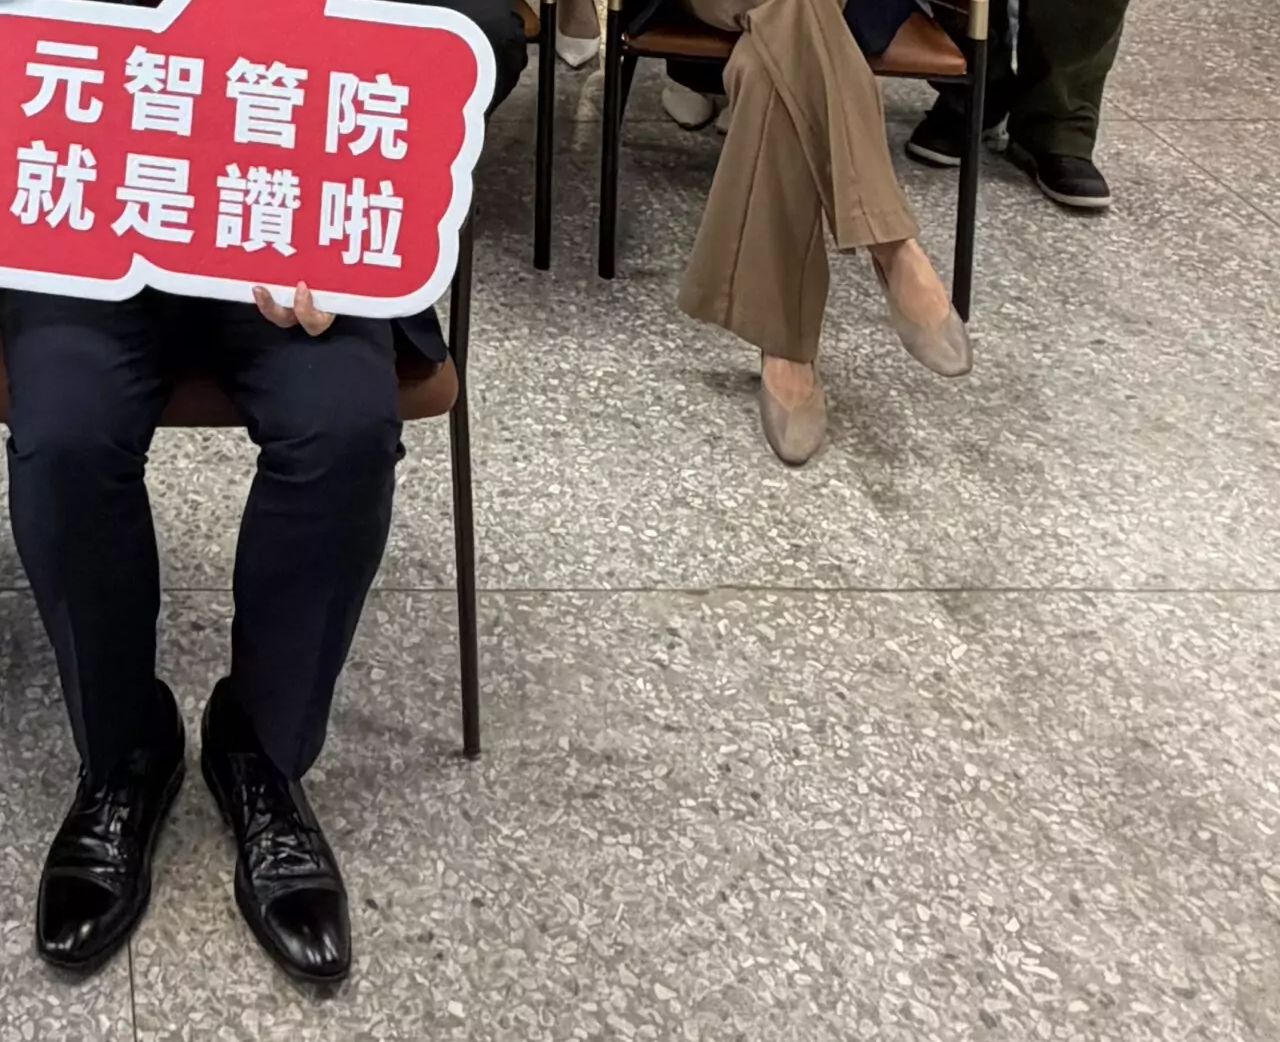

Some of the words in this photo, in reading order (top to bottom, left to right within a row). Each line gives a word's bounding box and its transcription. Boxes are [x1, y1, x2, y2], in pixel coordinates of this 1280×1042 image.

[20, 39, 412, 160] 元智管院
[10, 139, 406, 270] 就是讚啦
